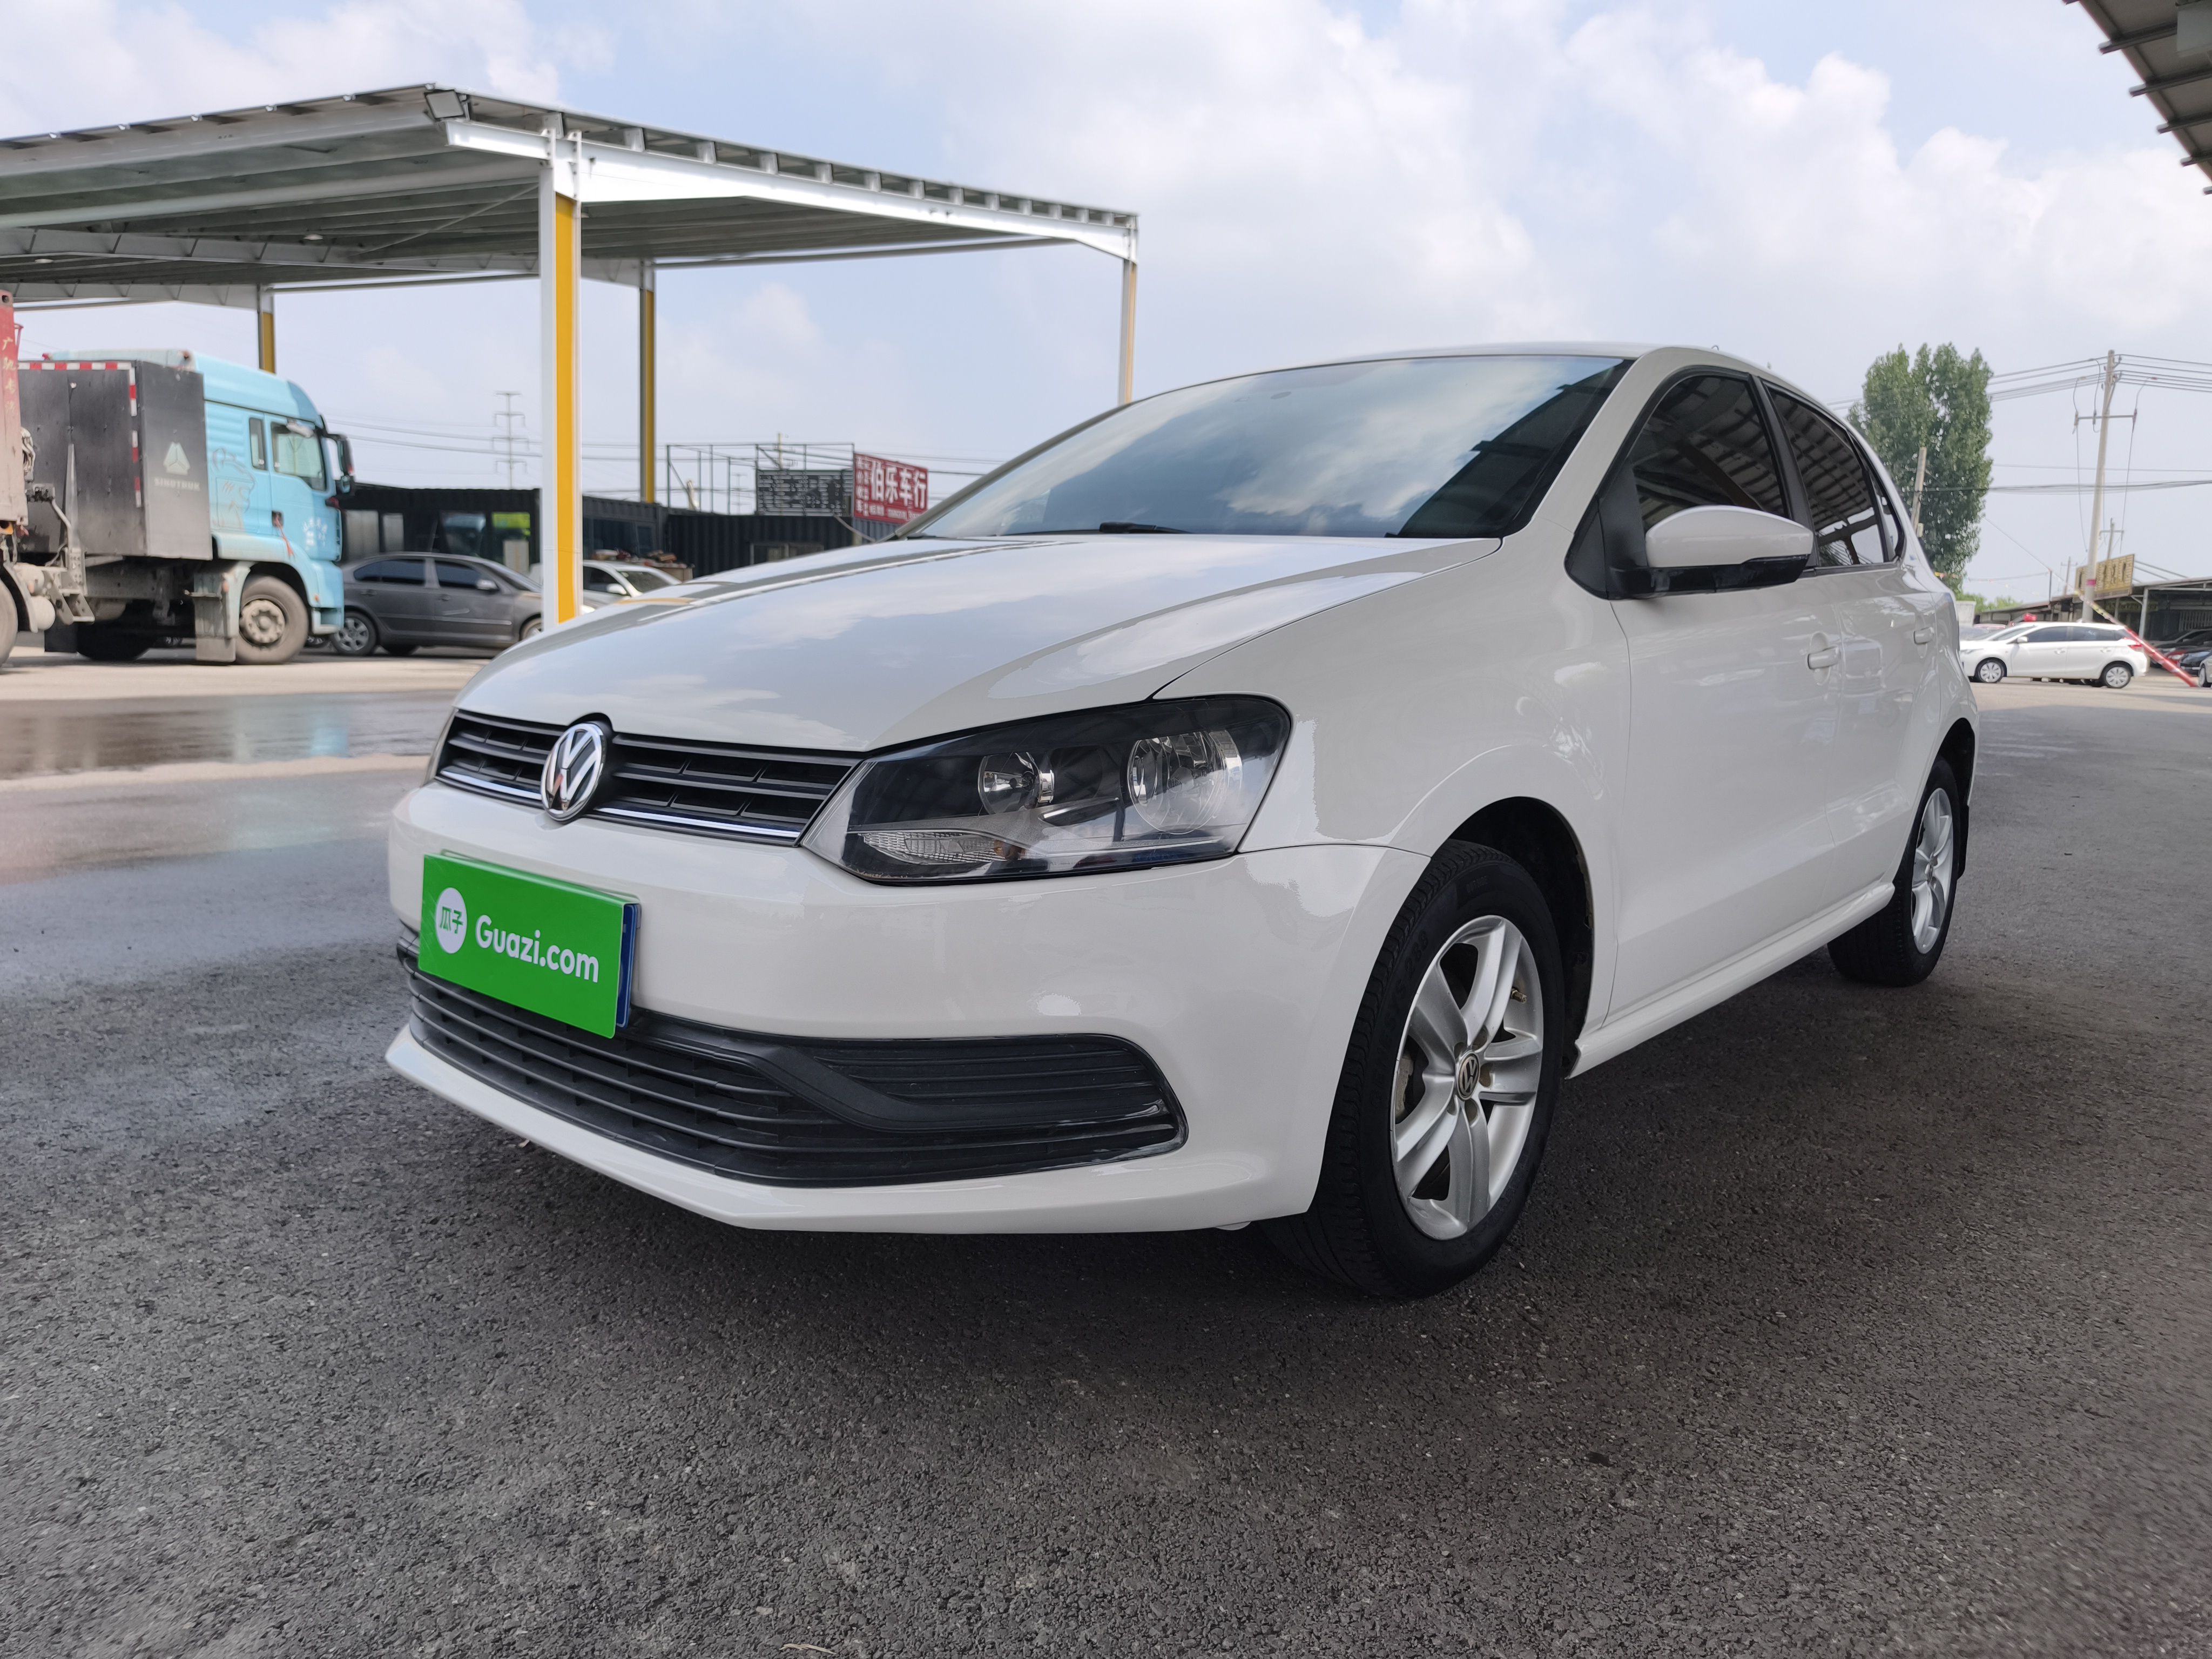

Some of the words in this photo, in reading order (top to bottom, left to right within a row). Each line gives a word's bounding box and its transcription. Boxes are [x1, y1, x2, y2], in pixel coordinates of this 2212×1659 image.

[871, 461, 927, 509] 伯乐车行
[440, 906, 463, 934] 瓜子
[475, 914, 599, 983] Guazi.com
